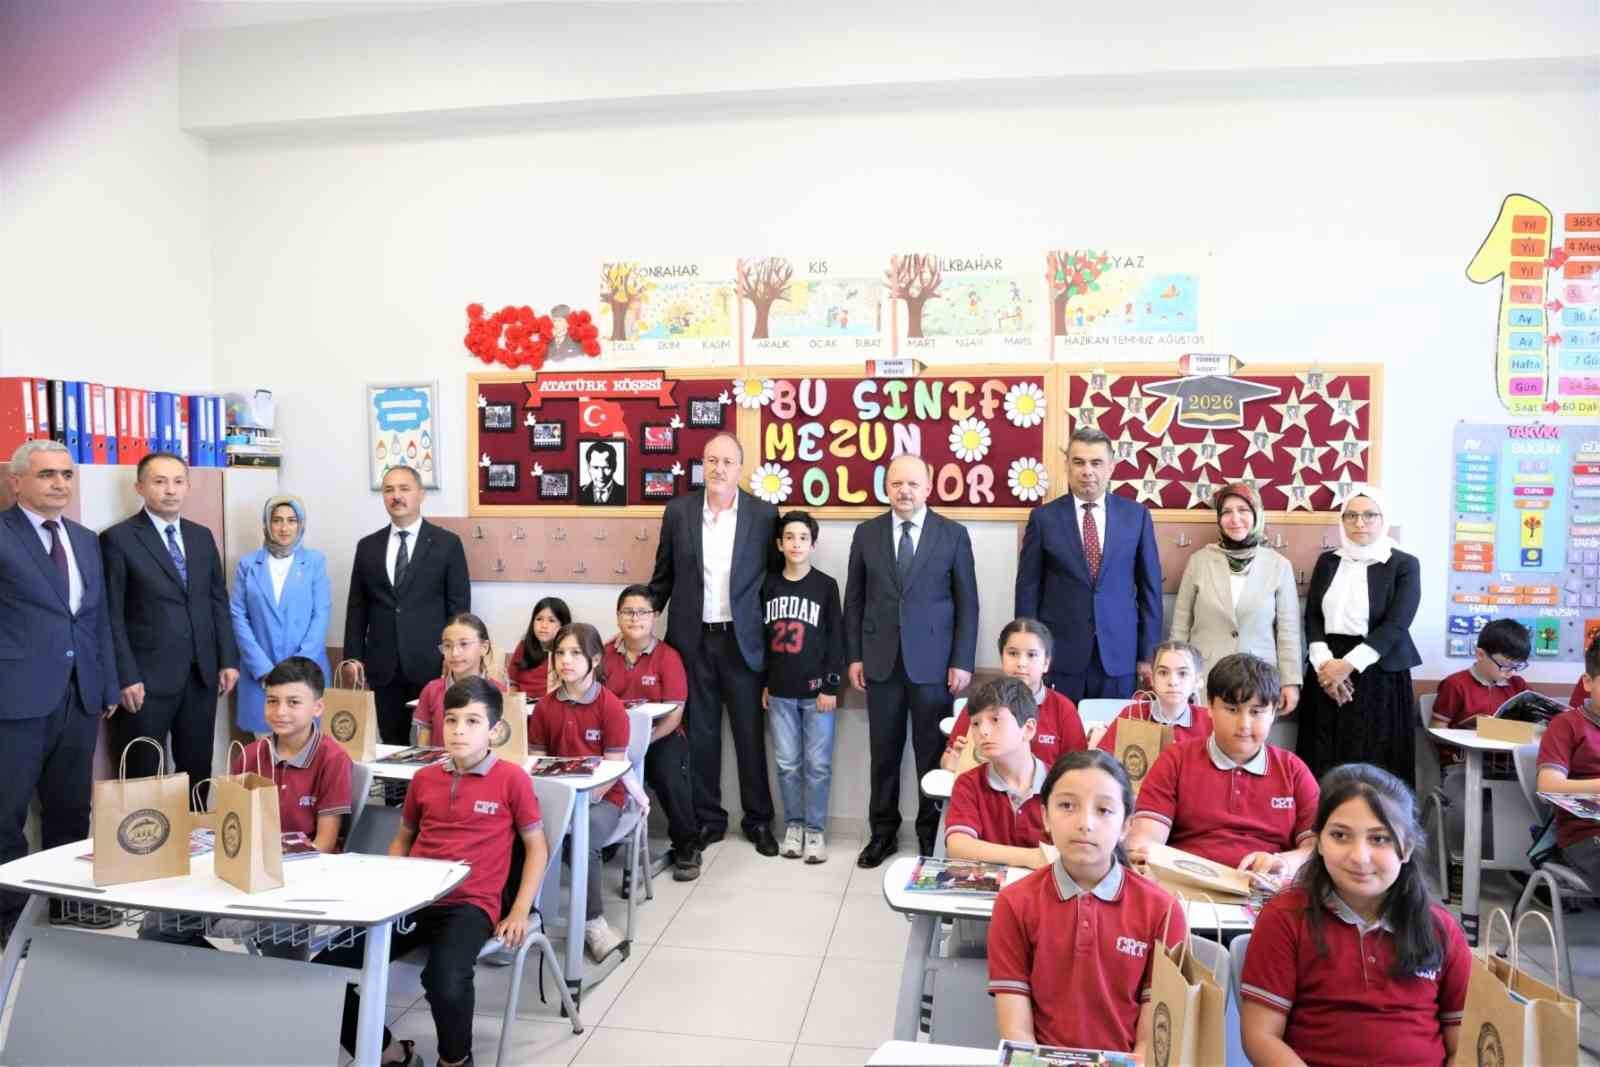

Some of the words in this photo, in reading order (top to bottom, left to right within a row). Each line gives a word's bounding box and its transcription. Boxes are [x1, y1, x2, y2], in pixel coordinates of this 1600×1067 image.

[1573, 216, 1592, 226] 365
[1111, 255, 1145, 269] YAZ
[1518, 313, 1532, 324] Ay
[1520, 336, 1534, 346] Ay
[1511, 359, 1540, 369] Hafta
[539, 379, 608, 392] ATATÜRK
[613, 377, 662, 394] KÖŞESİ
[1515, 382, 1537, 392] Gün
[770, 378, 828, 420] BU
[852, 379, 1008, 421] SINIF
[1188, 394, 1233, 410] 2026
[765, 419, 922, 462] MEZUN
[802, 463, 995, 506] OLUOR
[764, 595, 820, 628] JORDAN
[771, 620, 805, 654] 23
[1271, 796, 1295, 808] CRT
[1116, 936, 1148, 957] CRT
